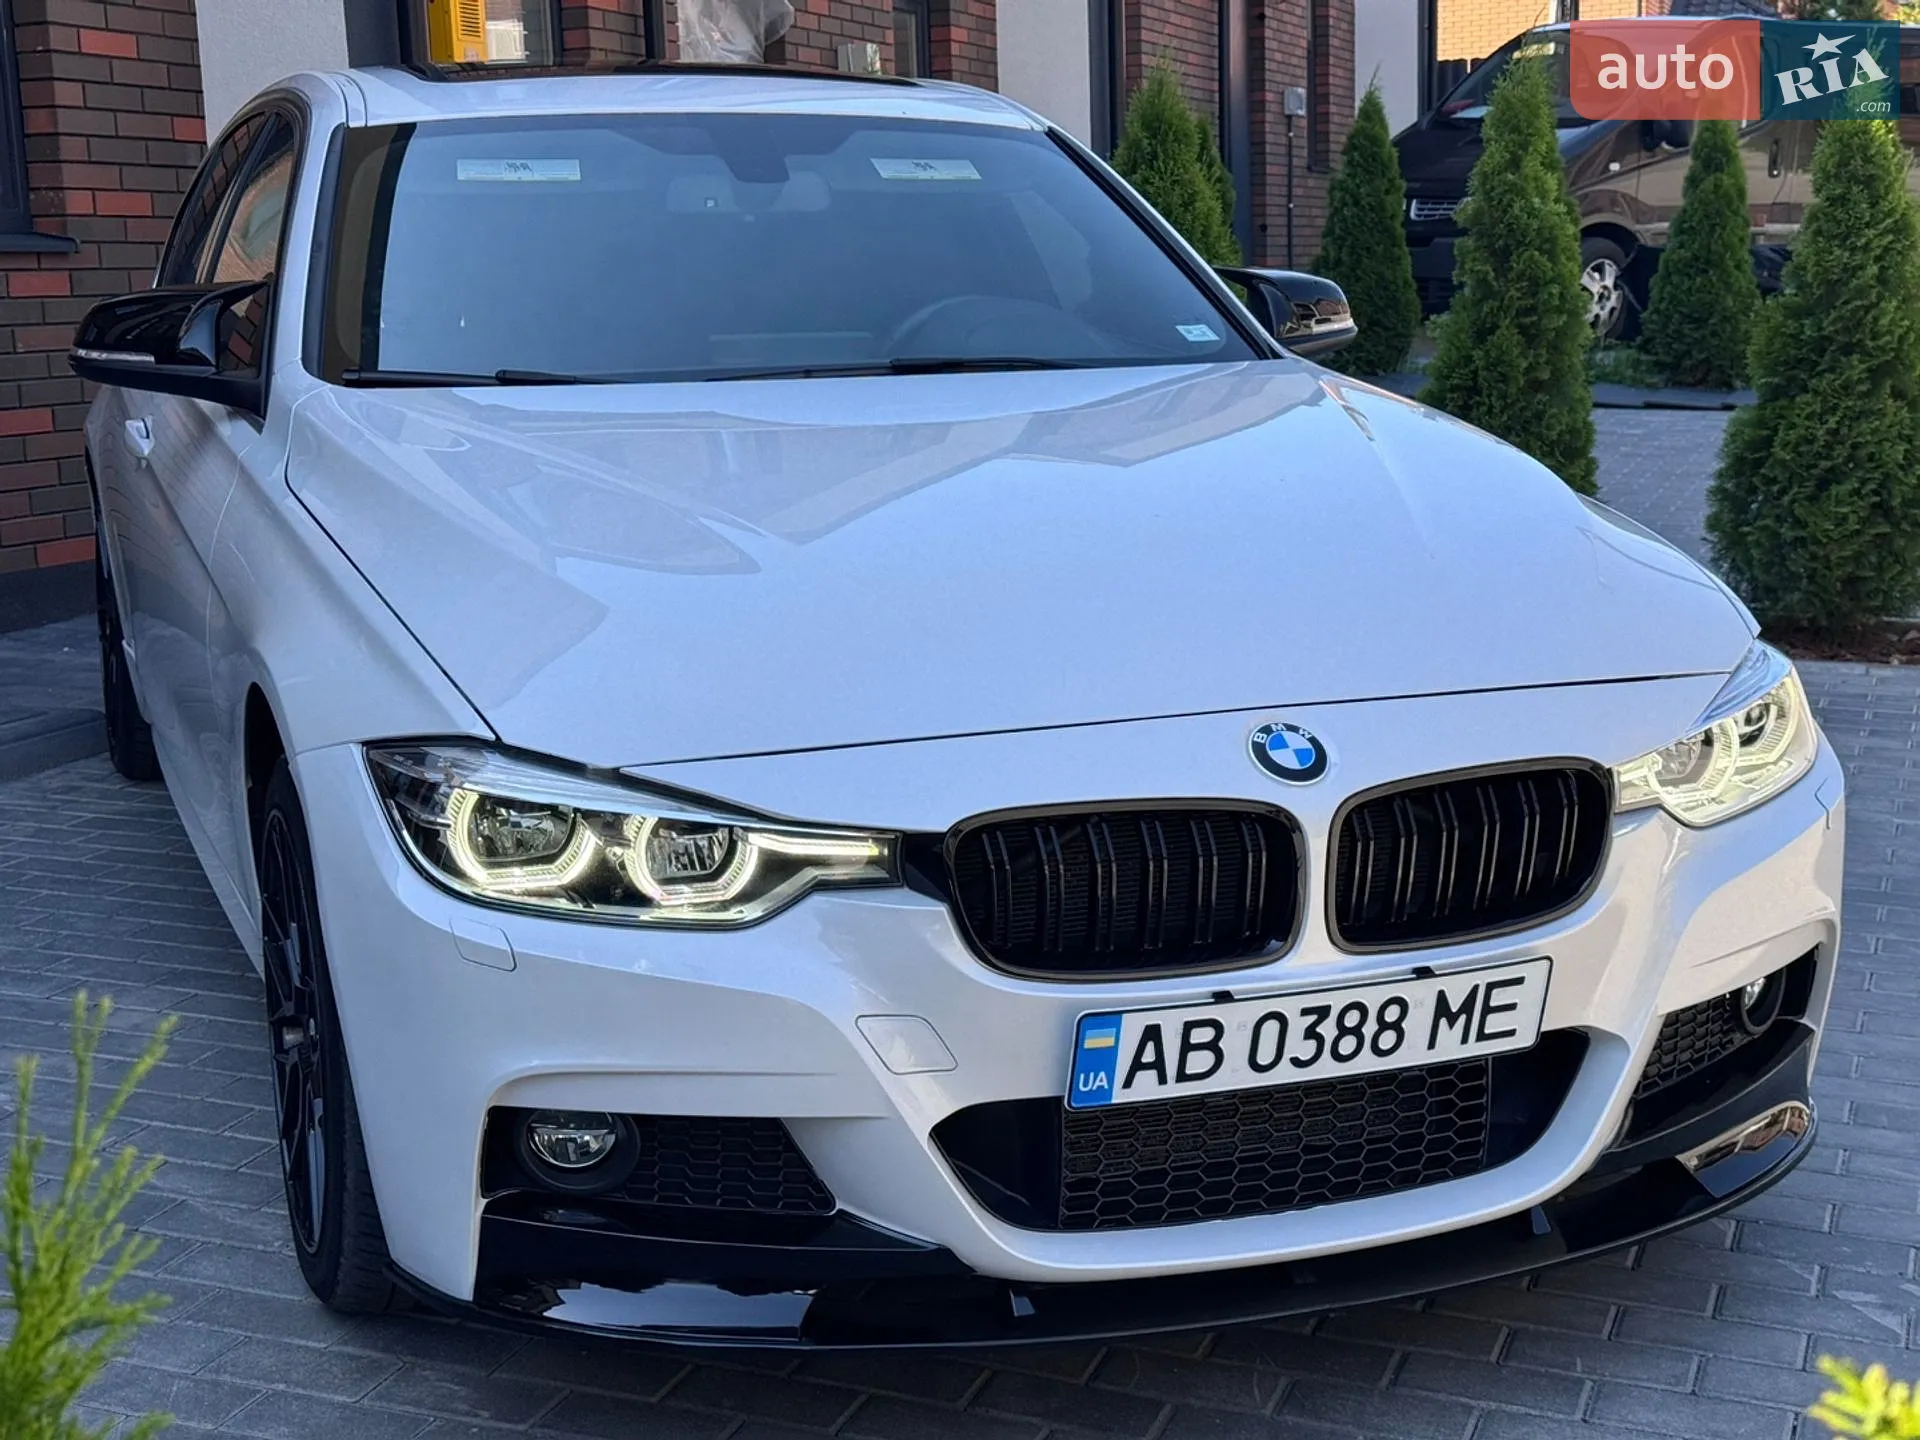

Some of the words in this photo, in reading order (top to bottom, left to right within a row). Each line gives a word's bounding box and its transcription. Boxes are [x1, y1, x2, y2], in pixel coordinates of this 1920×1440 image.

[1253, 723, 1313, 744] BMW
[1121, 1018, 1225, 1089] AB
[1248, 996, 1410, 1073] 0388
[1427, 976, 1526, 1050] ME
[1078, 1071, 1109, 1092] UA
